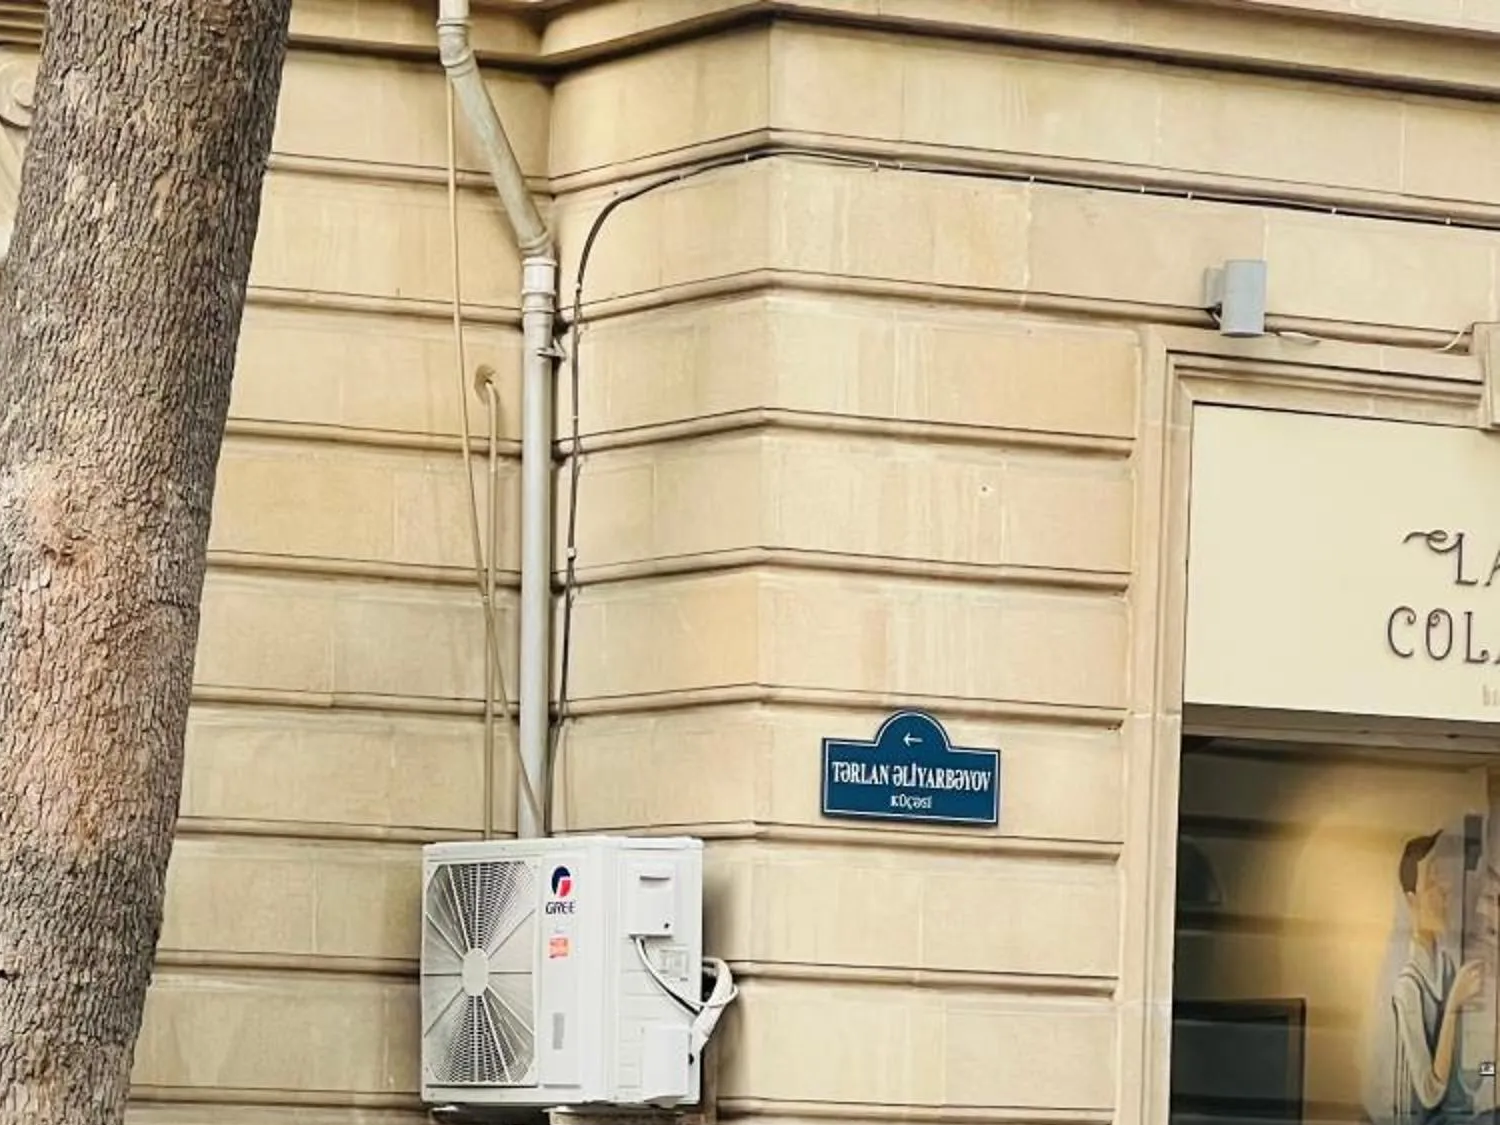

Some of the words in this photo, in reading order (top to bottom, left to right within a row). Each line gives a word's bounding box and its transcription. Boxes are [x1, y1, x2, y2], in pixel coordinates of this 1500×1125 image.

[1388, 606, 1500, 664] COL
[832, 761, 890, 785] TƏRLAN
[545, 901, 576, 915] GREE
